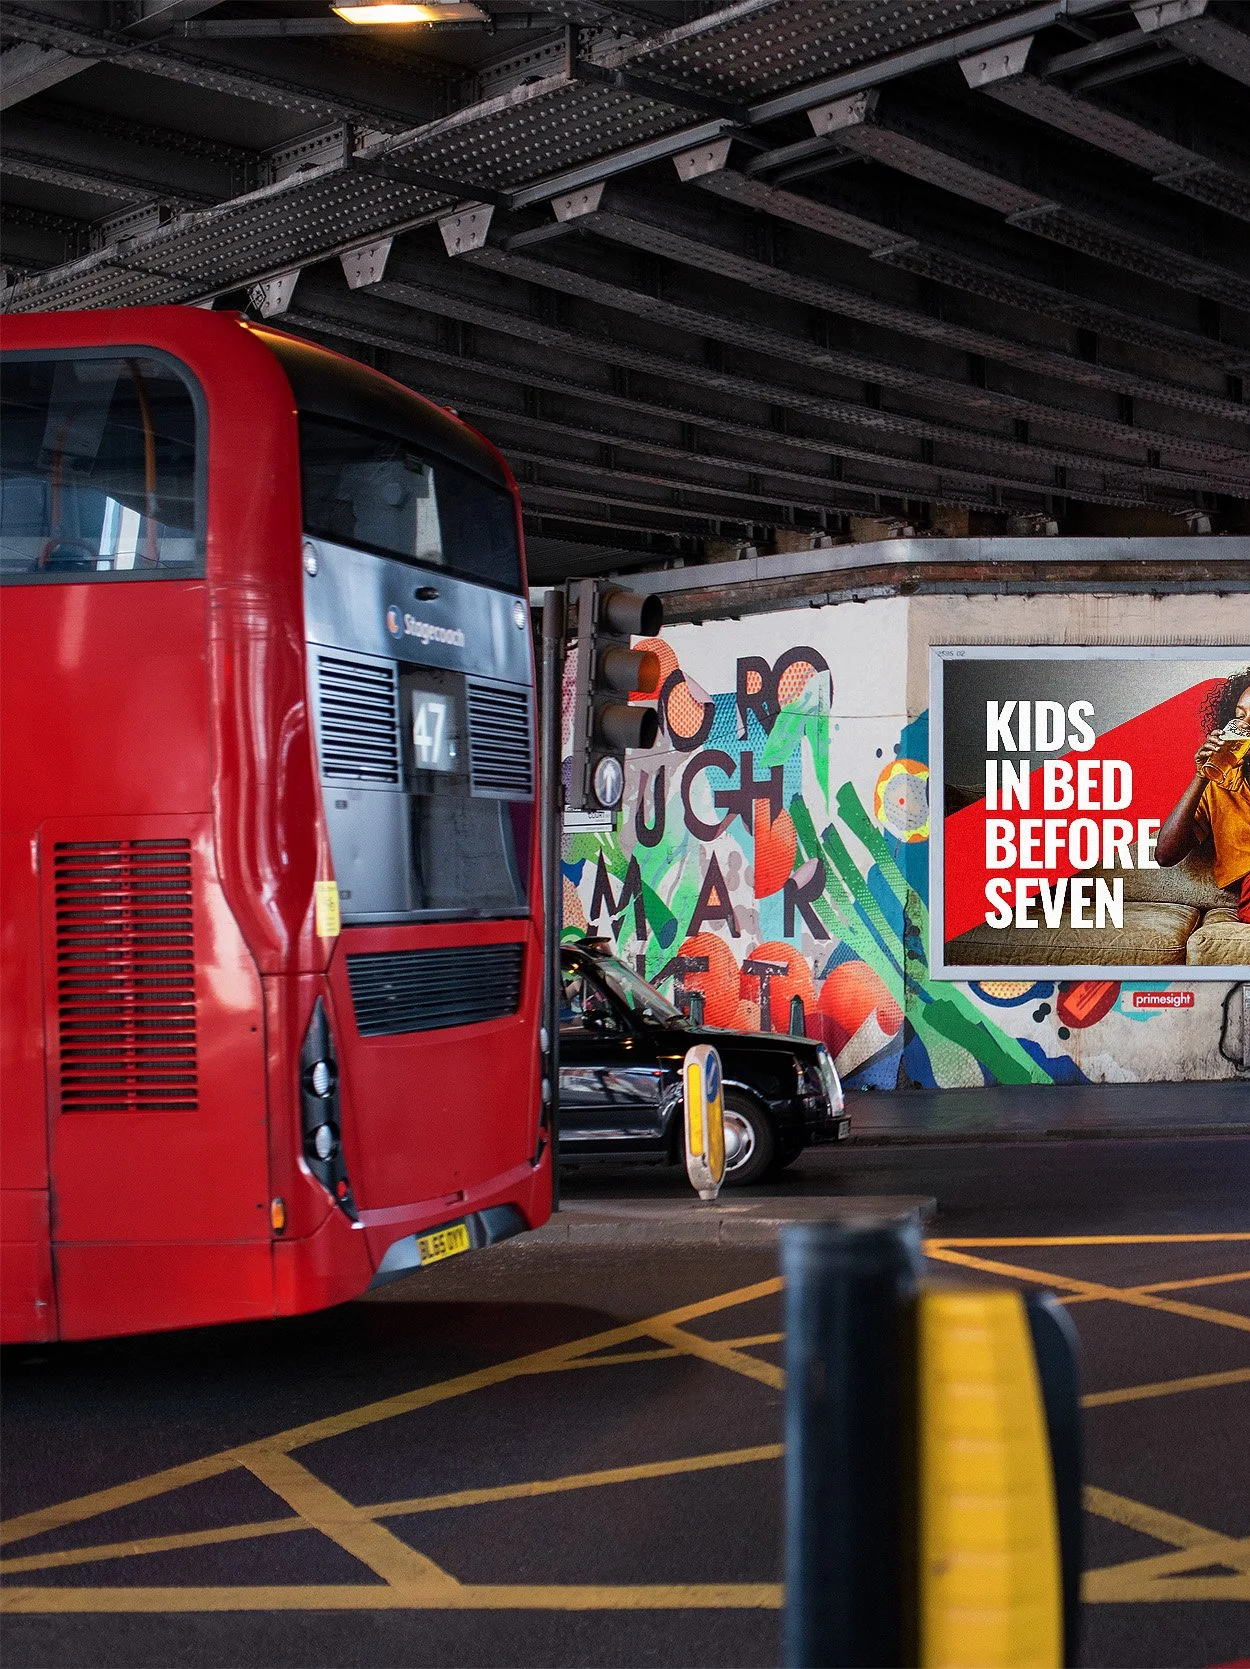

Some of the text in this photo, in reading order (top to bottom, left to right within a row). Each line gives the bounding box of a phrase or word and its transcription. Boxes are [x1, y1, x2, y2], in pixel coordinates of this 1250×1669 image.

[404, 613, 466, 648] Stagecoach
[413, 702, 447, 763] 47
[986, 700, 1096, 752] KIDS
[985, 759, 1133, 811] IN BED
[985, 818, 1161, 870] BEFORE
[984, 877, 1125, 929] SEVEN
[1136, 991, 1191, 1008] primesight
